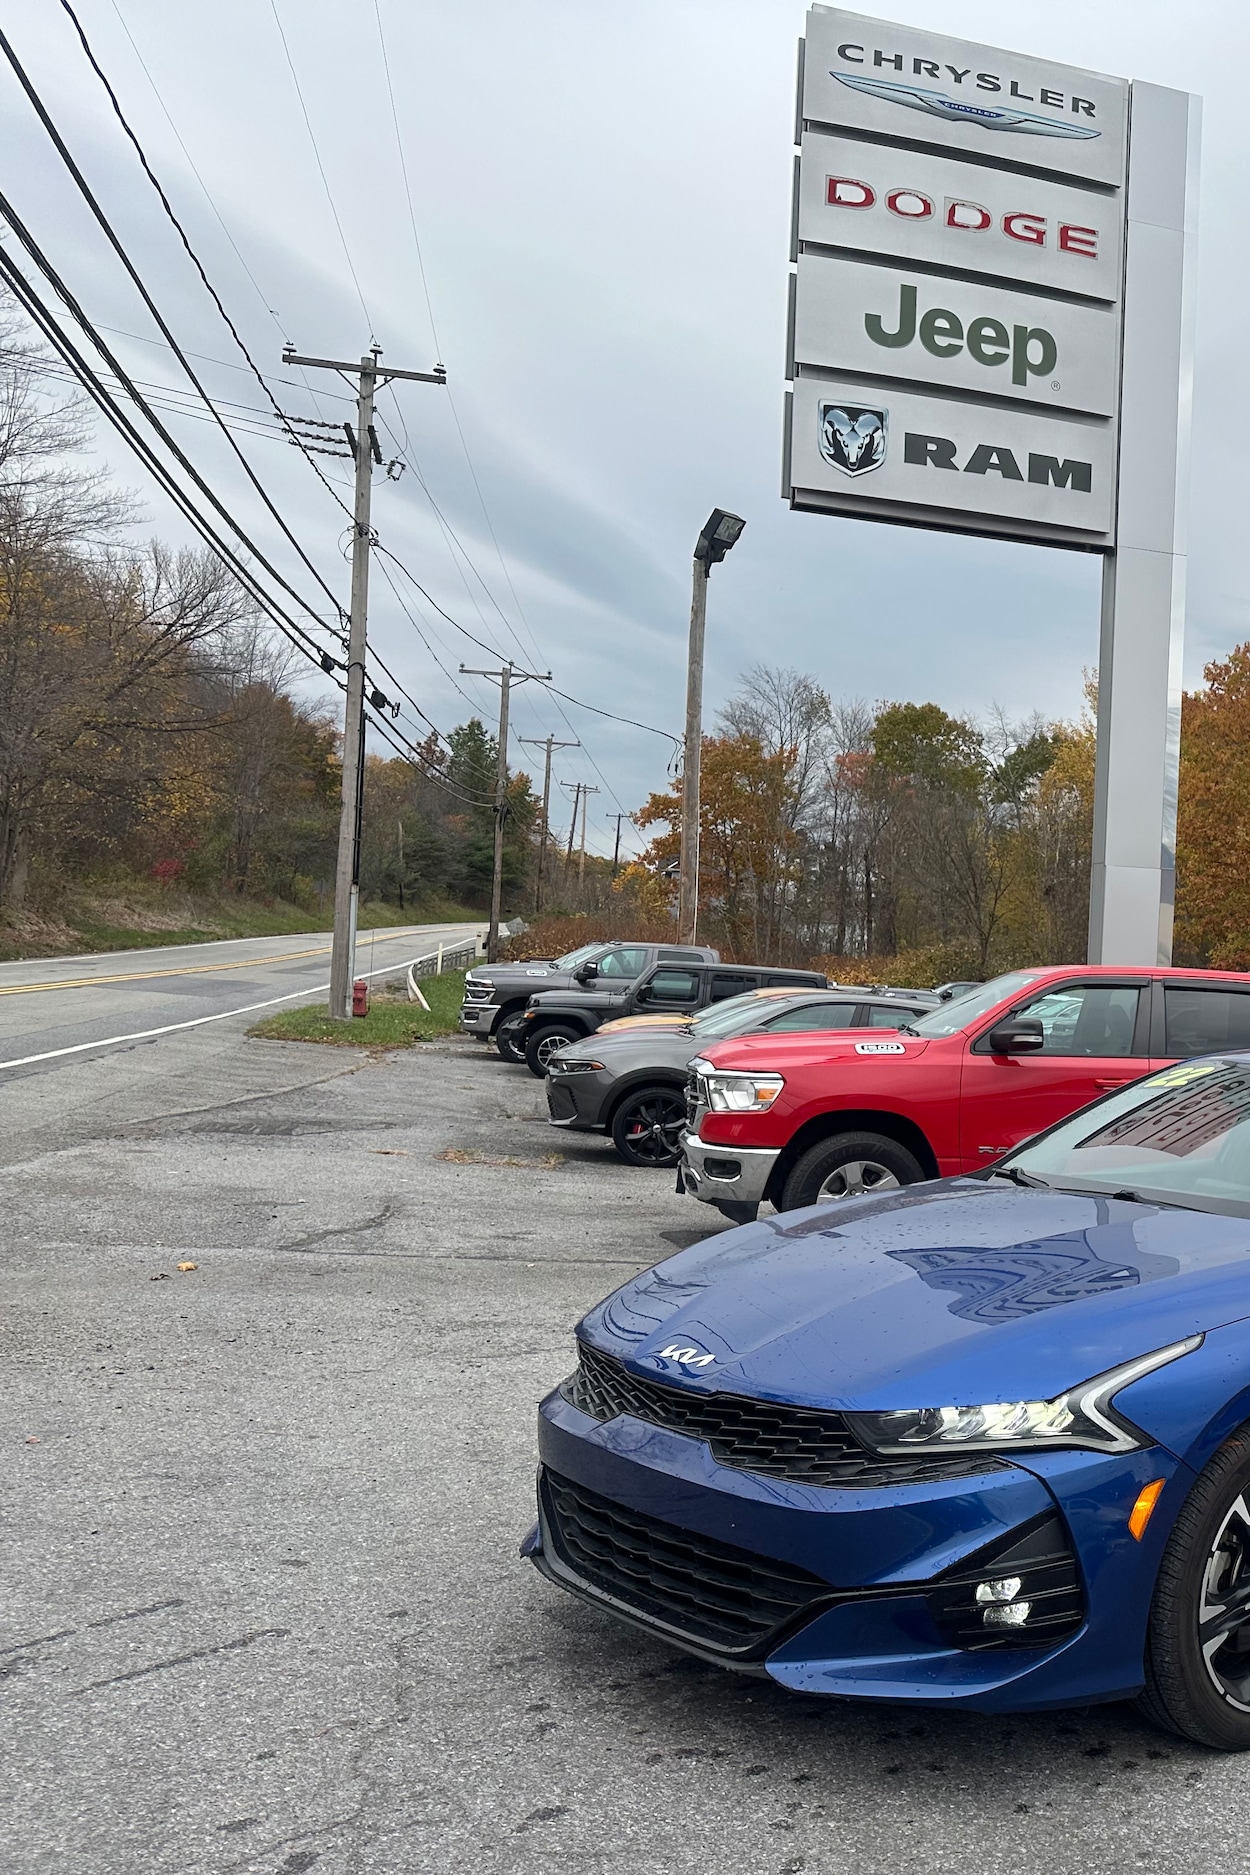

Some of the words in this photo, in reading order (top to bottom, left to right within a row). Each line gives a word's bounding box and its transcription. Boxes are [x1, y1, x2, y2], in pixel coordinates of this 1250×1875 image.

[836, 43, 1098, 118] CHRYSLER
[824, 174, 1100, 258] DODGE
[864, 283, 1058, 386] Jeep
[904, 431, 1092, 493] RAM
[1143, 1066, 1216, 1088] 22
